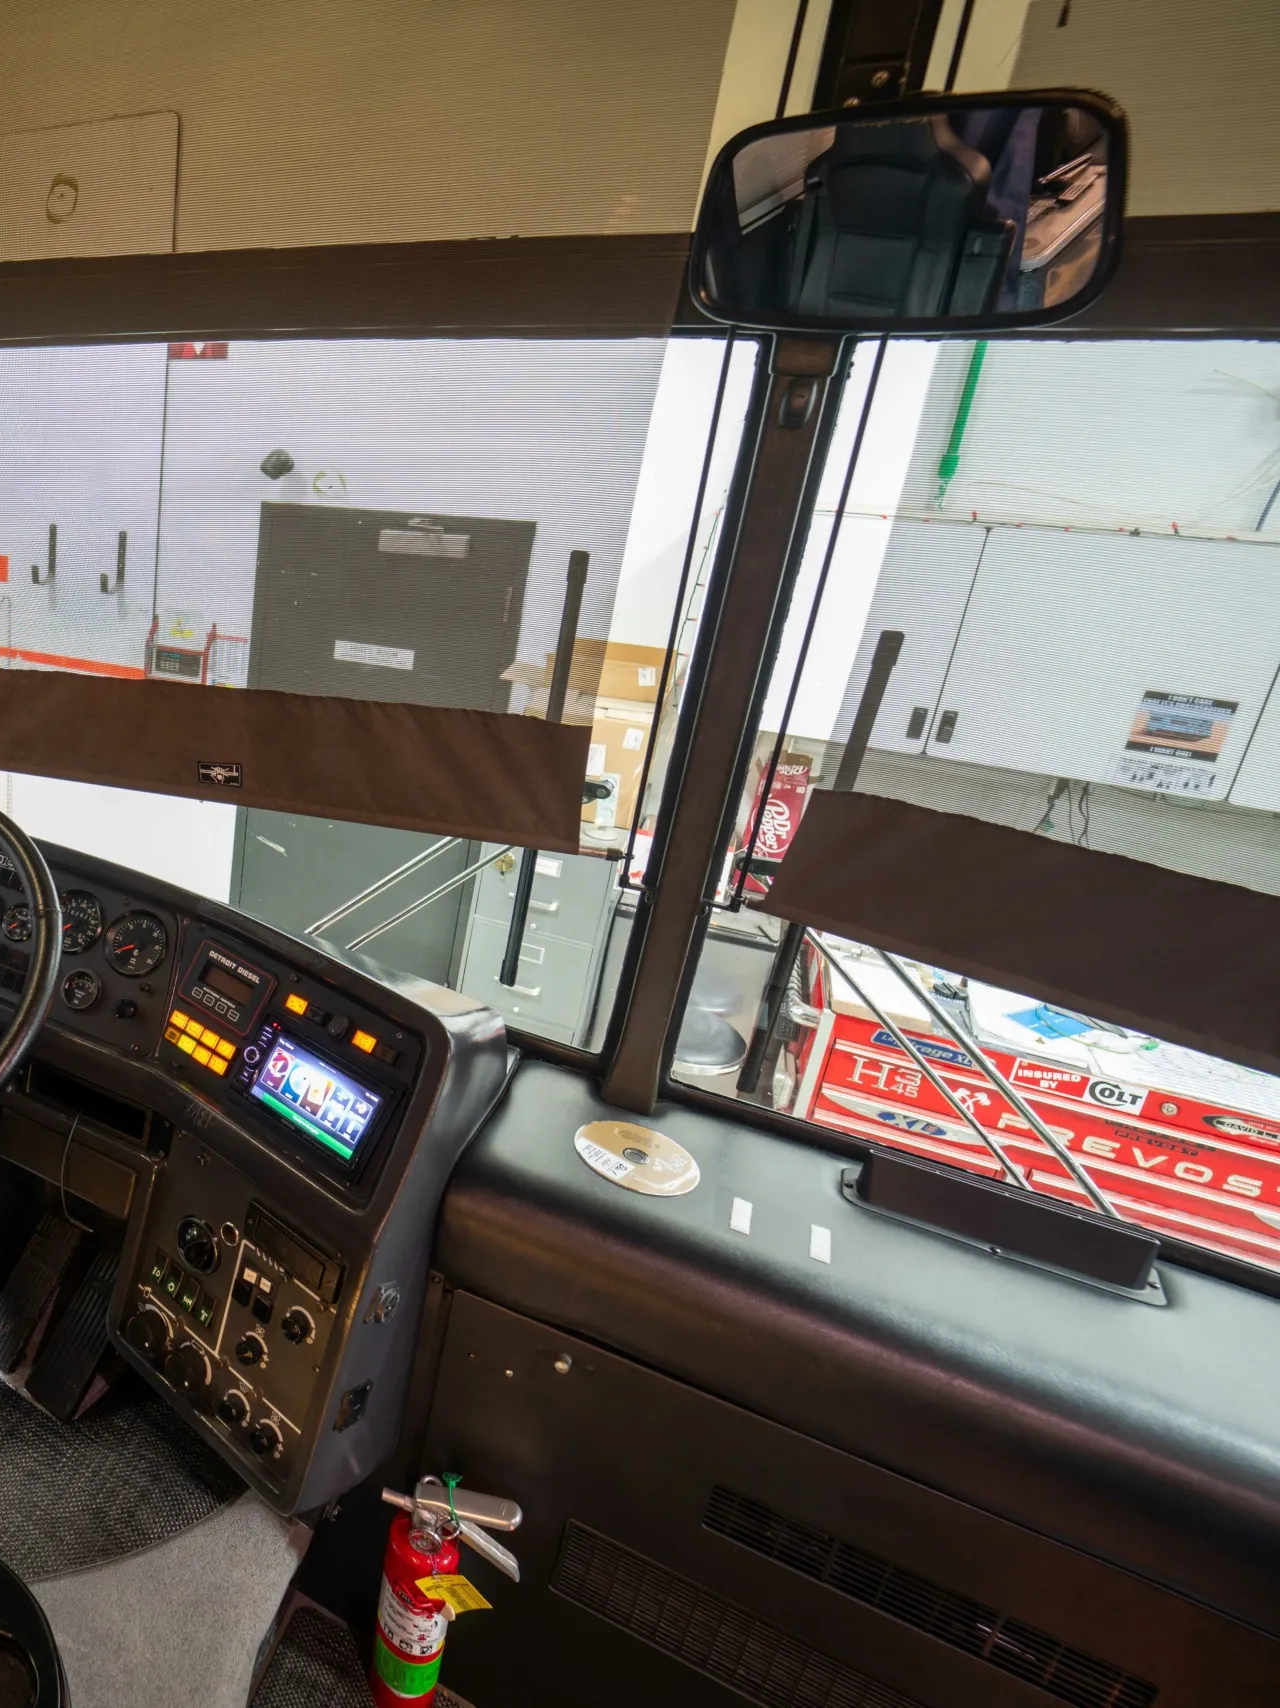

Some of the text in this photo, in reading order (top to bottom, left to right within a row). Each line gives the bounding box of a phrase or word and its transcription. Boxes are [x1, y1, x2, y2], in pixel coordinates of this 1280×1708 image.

[773, 819, 791, 840] Dr
[208, 949, 261, 984] DETROIT DIESEL
[1017, 1068, 1082, 1083] INSURED
[889, 1083, 919, 1099] 45
[1039, 1080, 1059, 1090] BY
[1088, 1080, 1143, 1107] COLT
[1224, 1121, 1259, 1135] DAVID
[997, 1112, 1280, 1199] PREVOS
